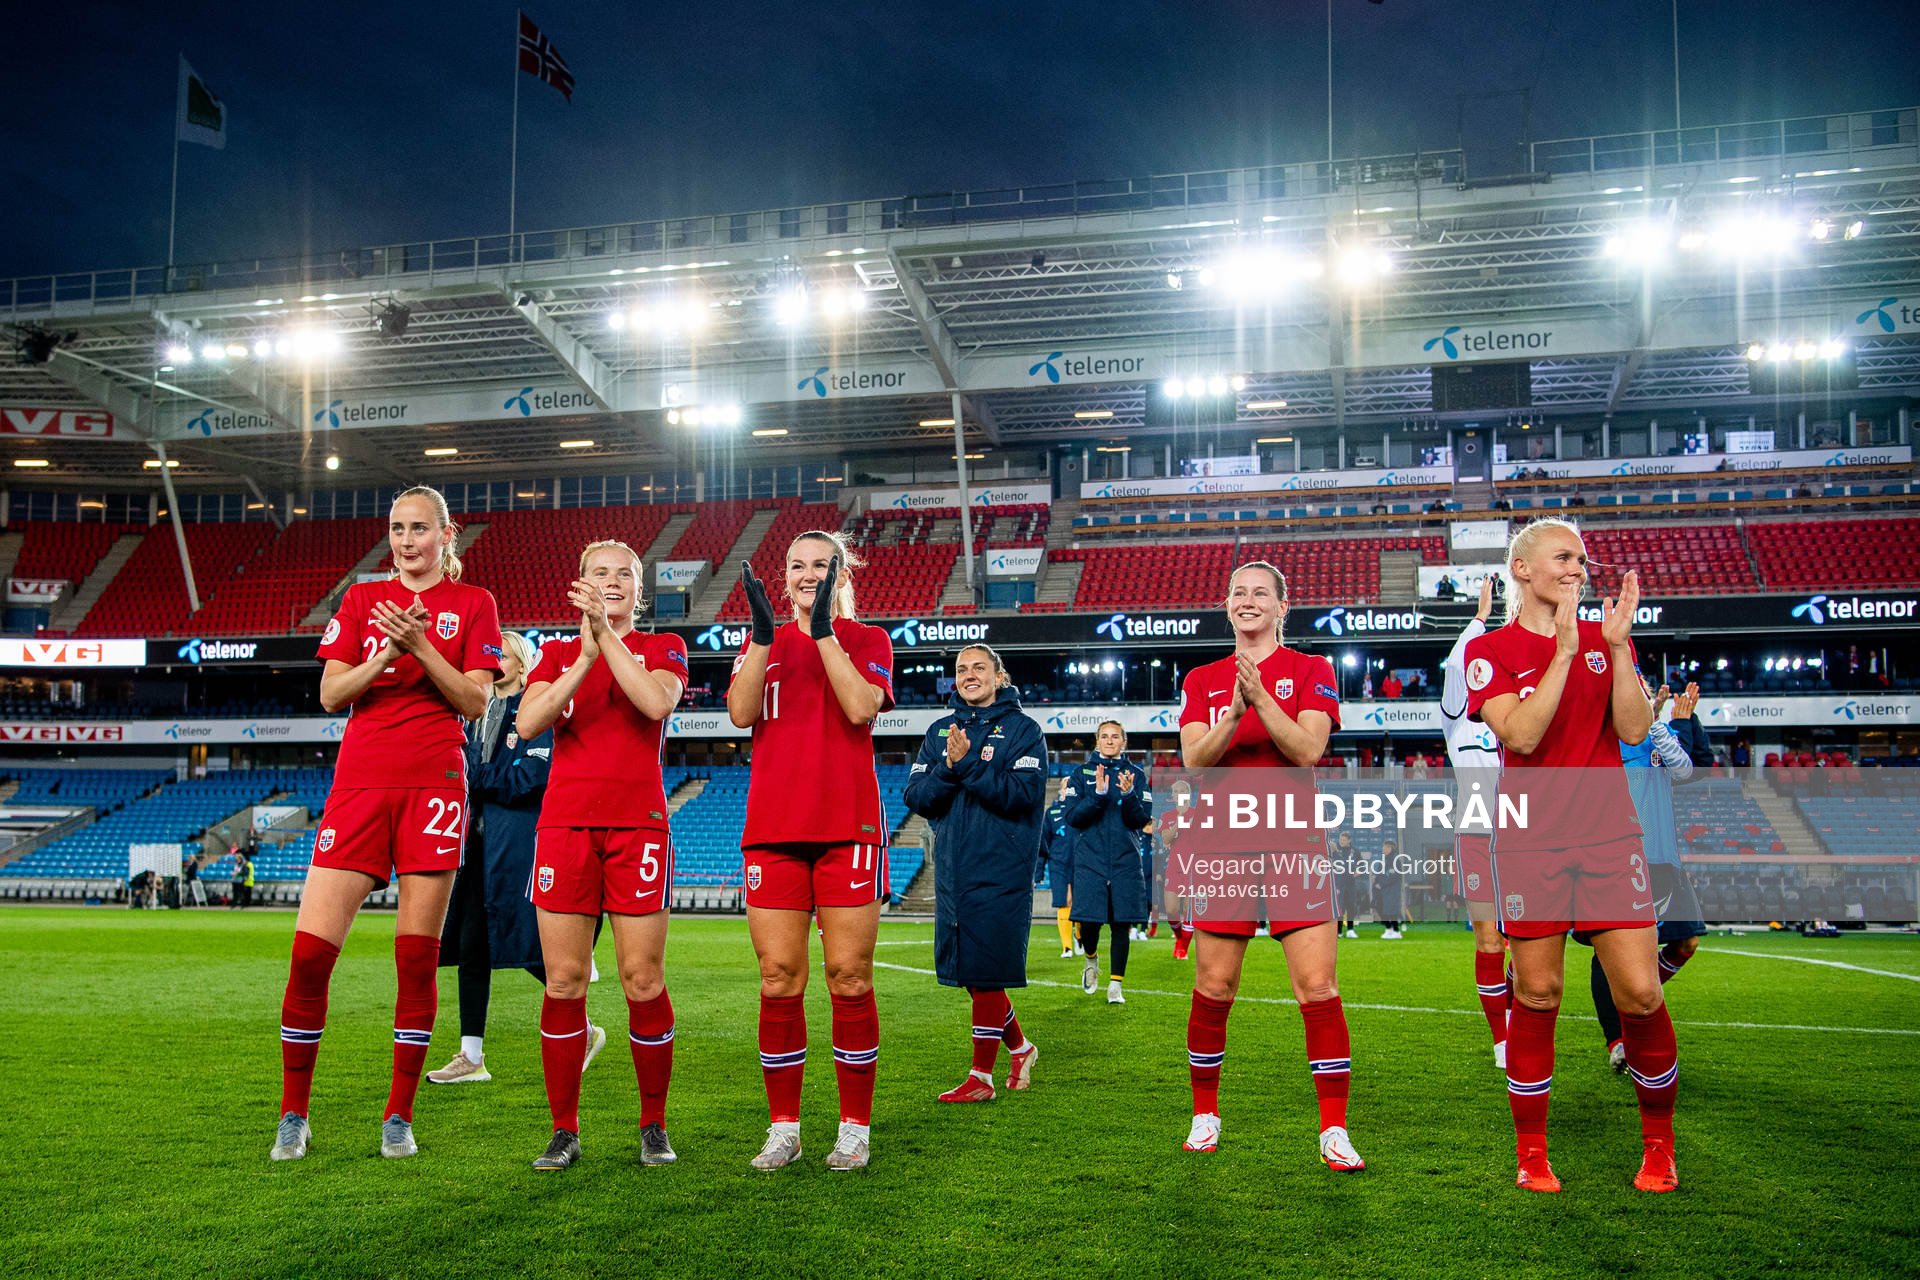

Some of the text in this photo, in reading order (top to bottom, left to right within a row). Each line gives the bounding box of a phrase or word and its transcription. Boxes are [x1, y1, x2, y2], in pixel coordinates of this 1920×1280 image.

[1463, 330, 1552, 351] telenor
[1064, 356, 1144, 376] telenor
[831, 371, 906, 390] telenor
[534, 390, 594, 410] teleno
[343, 403, 408, 422] telenor
[2, 410, 108, 435] VG
[1735, 459, 1783, 470] telenor
[1844, 453, 1893, 465] telenor
[1630, 463, 1676, 475] telenor
[1298, 477, 1339, 489] telenor
[1394, 471, 1438, 484] telenor
[1112, 486, 1151, 497] telenor
[1204, 481, 1244, 493] telenor
[908, 495, 945, 506] telenor
[990, 490, 1028, 502] telenor
[1005, 556, 1039, 566] telenor
[1827, 598, 1917, 619] telenor
[1125, 615, 1201, 636] telenor
[1345, 609, 1424, 631] telenor
[917, 621, 990, 641] telenor
[23, 643, 102, 662] VG
[200, 640, 258, 660] telenor
[1384, 709, 1432, 722] telenor
[1856, 703, 1912, 717] telenor
[680, 719, 719, 730] telenor
[873, 716, 910, 728] elenor
[178, 726, 212, 737] telenor
[256, 725, 291, 737] telenor
[422, 796, 462, 839] 22
[638, 842, 661, 882] 5
[1629, 853, 1648, 893] 3
